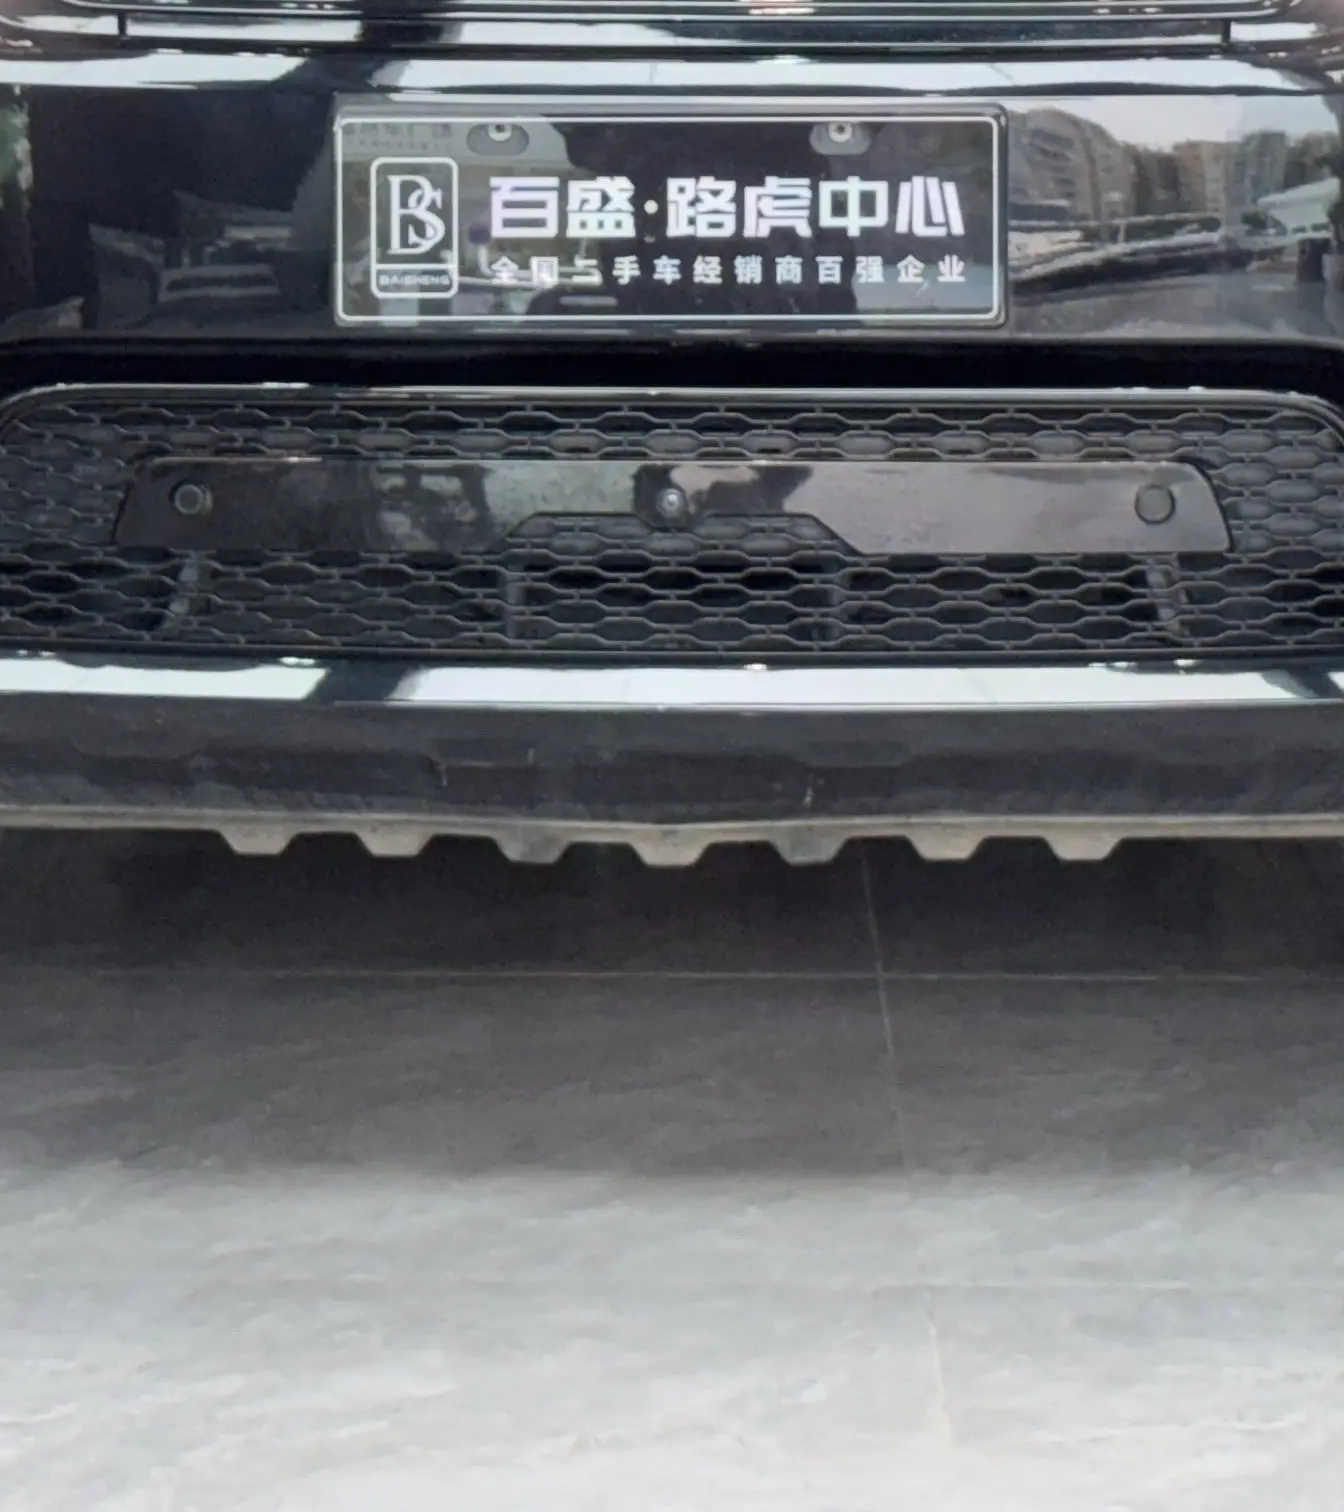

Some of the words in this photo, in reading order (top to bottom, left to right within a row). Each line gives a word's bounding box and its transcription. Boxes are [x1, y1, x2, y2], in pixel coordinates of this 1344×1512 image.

[379, 274, 450, 286] BAISHENG
[490, 254, 967, 286] 全国二手车经销商百强企业
